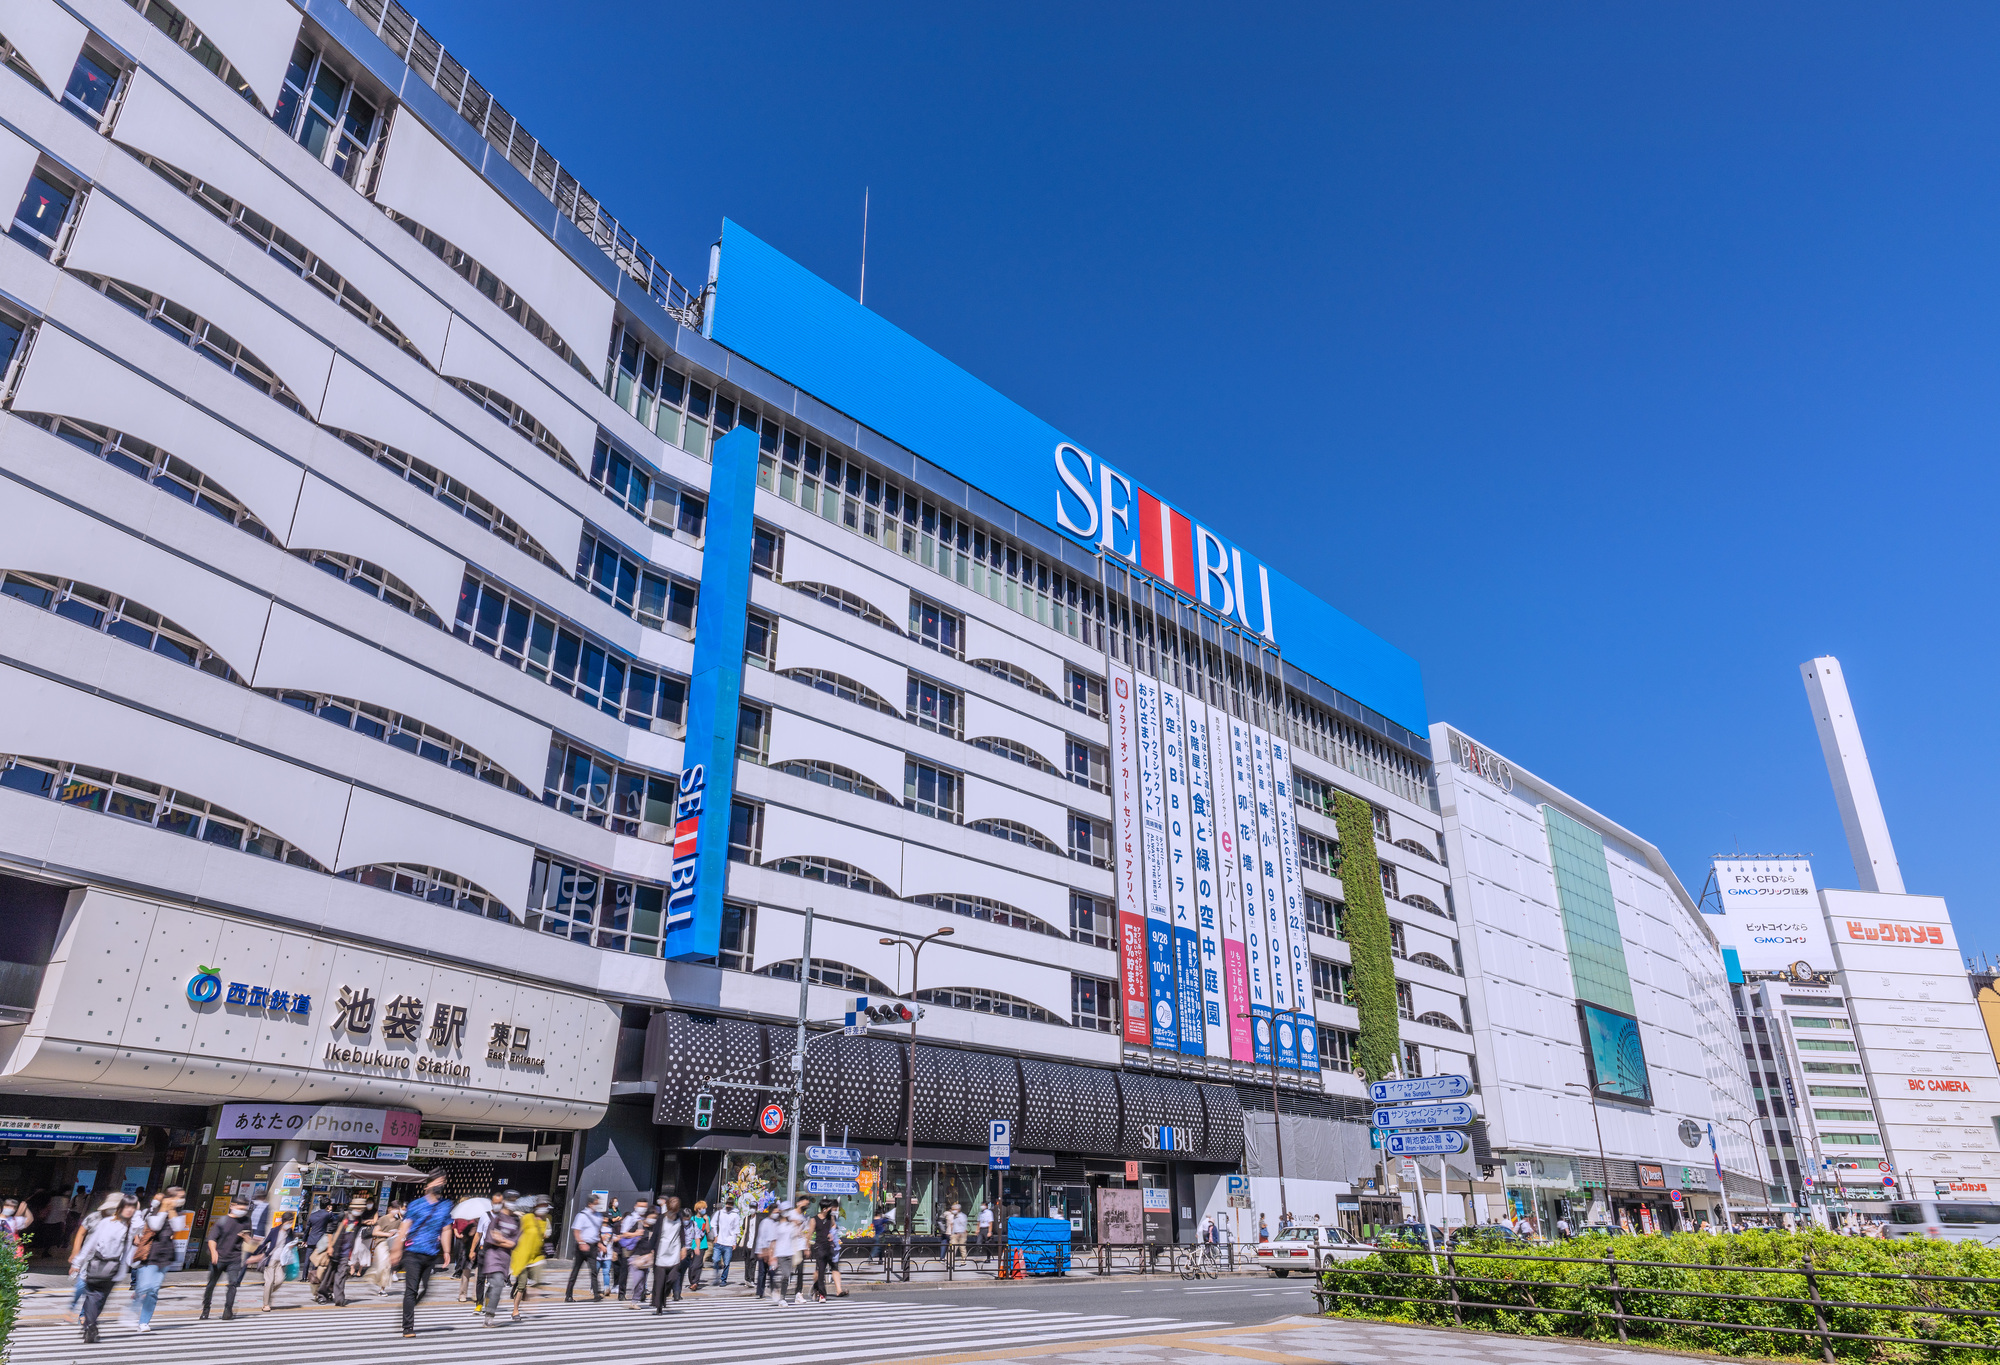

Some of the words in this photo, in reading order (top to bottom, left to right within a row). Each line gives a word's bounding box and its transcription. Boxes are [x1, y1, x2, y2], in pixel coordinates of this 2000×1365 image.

[1055, 442, 1275, 644] SEIBU
[1149, 688, 1158, 736] ディズニー
[1119, 703, 1129, 762] クラブ・オン
[1138, 683, 1153, 813] おひさまマーケット
[1456, 733, 1513, 793] PARCO
[1122, 768, 1131, 803] カード
[1164, 692, 1187, 921] 天空のBBQテラス
[666, 763, 706, 930] SEIBU
[1281, 811, 1293, 883] SAKAGURA
[1222, 831, 1237, 934] e.デパート
[1728, 888, 1809, 896] GMOクリック証券
[1246, 883, 1255, 917] 9/8
[1268, 888, 1277, 922] 9/8
[1289, 896, 1299, 930] 9/22
[1152, 930, 1168, 945] 9/28
[1746, 922, 1808, 931] ビットコインなら
[1754, 936, 1806, 944] GMOコイン
[1846, 920, 1944, 945] ビックカメラ
[1124, 923, 1137, 996] 5%貯まる
[1152, 960, 1171, 976] 10/11
[1250, 933, 1263, 1000] OPEN
[1272, 938, 1285, 1004] OPEN
[1230, 950, 1239, 1003] リニューアル
[1293, 945, 1306, 1010] OPEN
[225, 981, 311, 1016] 西武鉄道
[330, 984, 468, 1050] 池袋駅
[845, 1026, 867, 1036] 時差式
[490, 1021, 531, 1051] 東口
[325, 1043, 410, 1070] Ikebukuro
[417, 1056, 471, 1078] Station
[487, 1048, 506, 1061] East
[510, 1052, 545, 1067] Entrance
[1389, 1080, 1445, 1092] イケ・サンパーク
[1412, 1090, 1432, 1098] Sunpark
[1908, 1079, 1926, 1091] BIC
[1927, 1080, 1971, 1093] CAMERA
[235, 1111, 381, 1135] あなたのiPhone、
[1391, 1107, 1450, 1119] サンシャインシティ
[1427, 1117, 1437, 1125] City
[993, 1123, 1006, 1142] P
[1141, 1125, 1193, 1151] SEIBU
[1405, 1135, 1442, 1145] 南池袋公園
[333, 1145, 379, 1159] TOMONY
[1228, 1176, 1243, 1194] P
[1949, 1182, 1988, 1192] ビックカメラ
